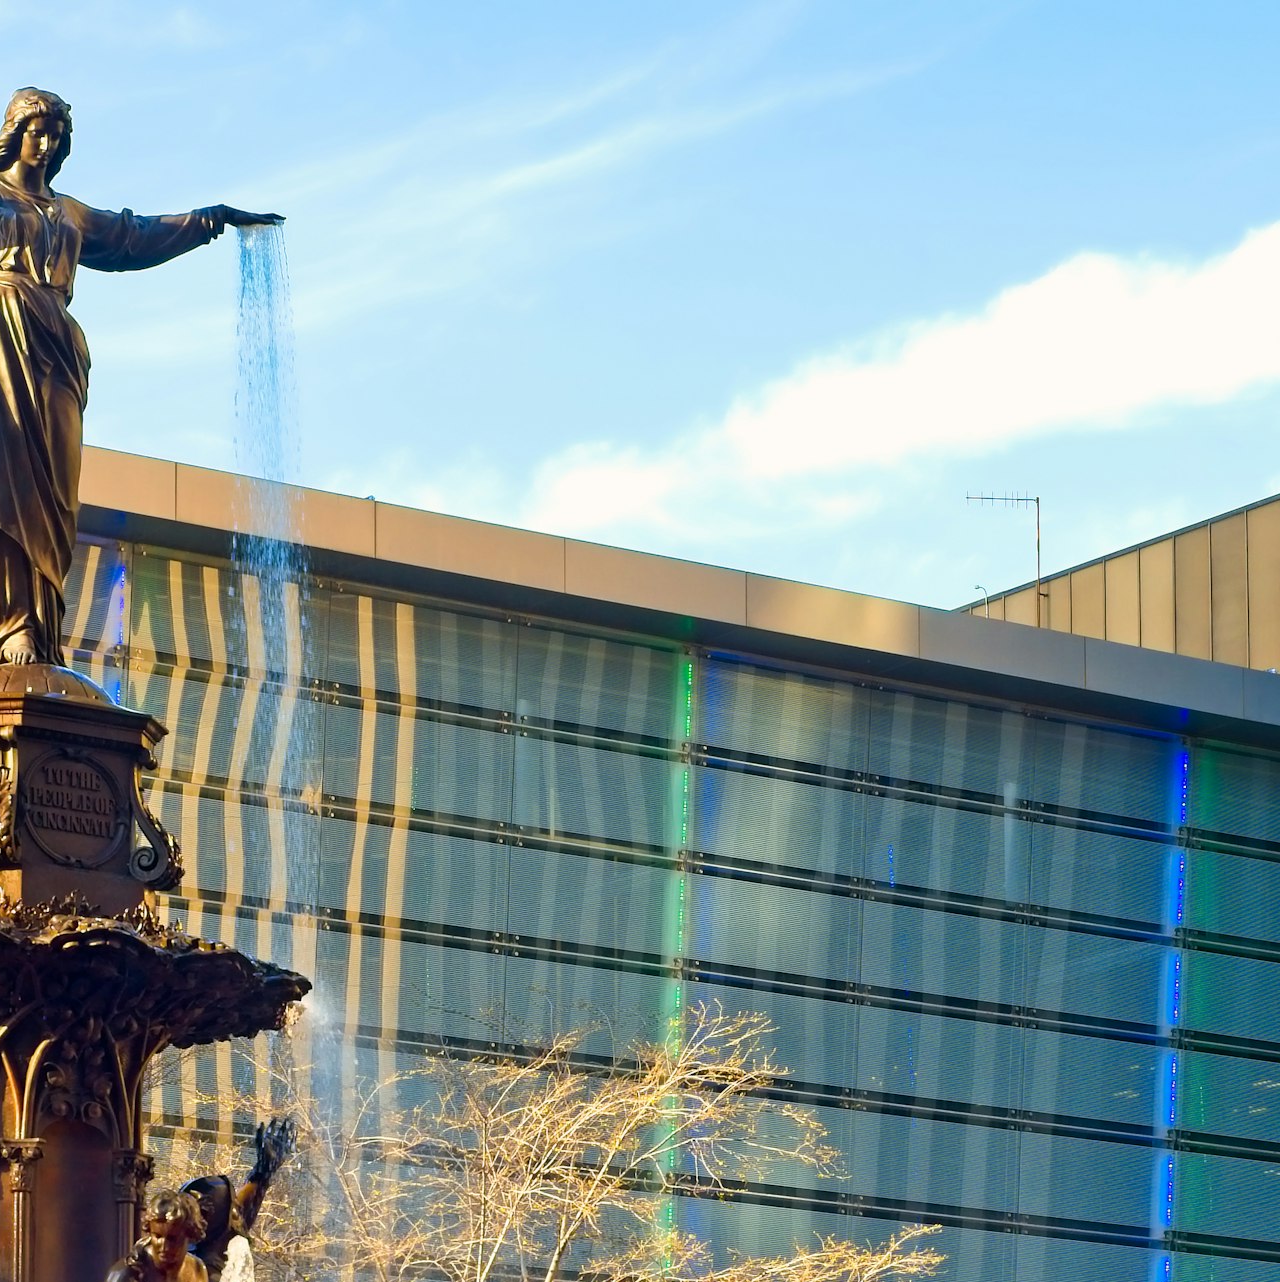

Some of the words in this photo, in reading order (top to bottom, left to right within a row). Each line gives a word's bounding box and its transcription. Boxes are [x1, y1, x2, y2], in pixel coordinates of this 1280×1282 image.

[66, 768, 102, 792] THE
[30, 787, 93, 814] PEOPLE
[94, 797, 117, 817] OF
